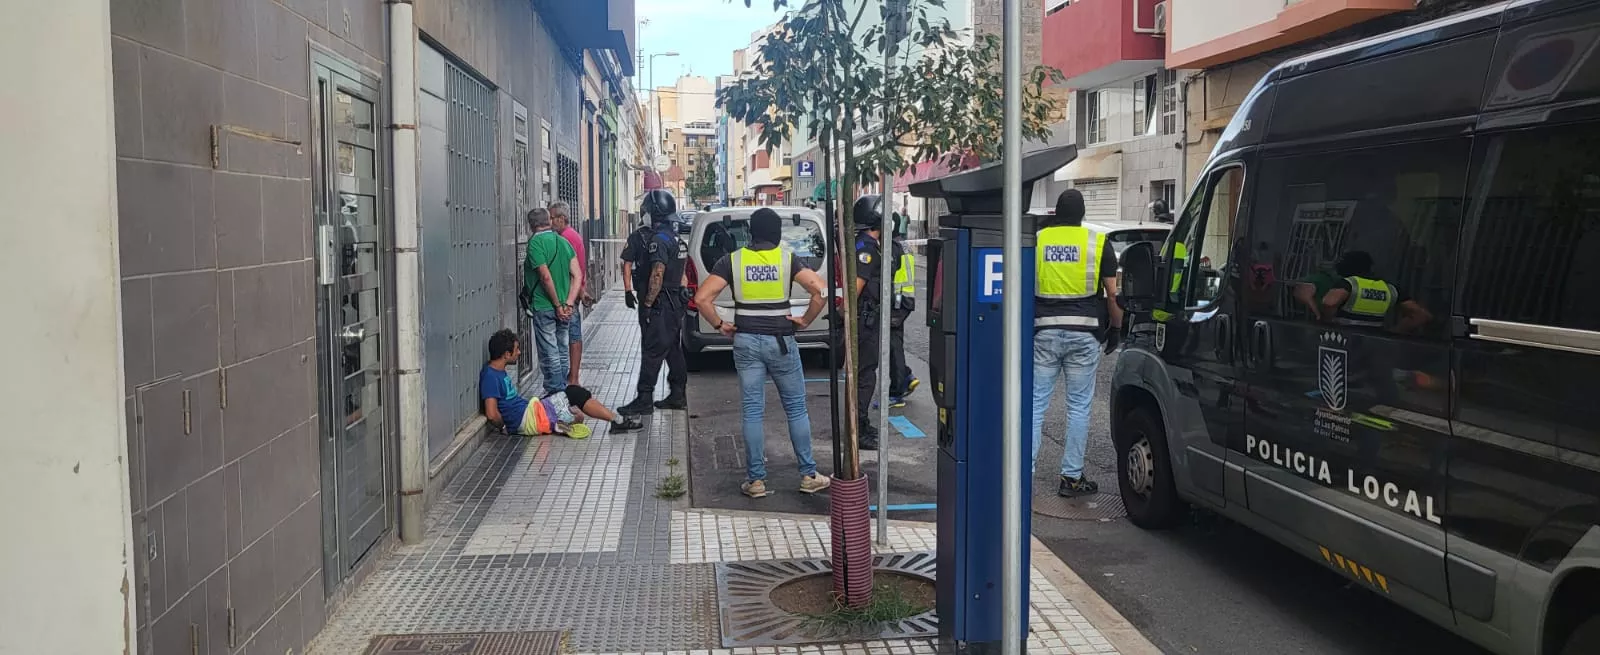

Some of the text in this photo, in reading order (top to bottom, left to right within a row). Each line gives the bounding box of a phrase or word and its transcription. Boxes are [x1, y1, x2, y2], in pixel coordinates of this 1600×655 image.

[1045, 245, 1078, 254] POLICIA
[1045, 253, 1078, 262] LOCAL
[745, 265, 778, 273] POLICIA
[746, 272, 778, 281] LOCAL
[1321, 420, 1331, 429] Las
[1331, 422, 1350, 434] Palmas
[1246, 434, 1441, 524] POLICIA LOCAL
